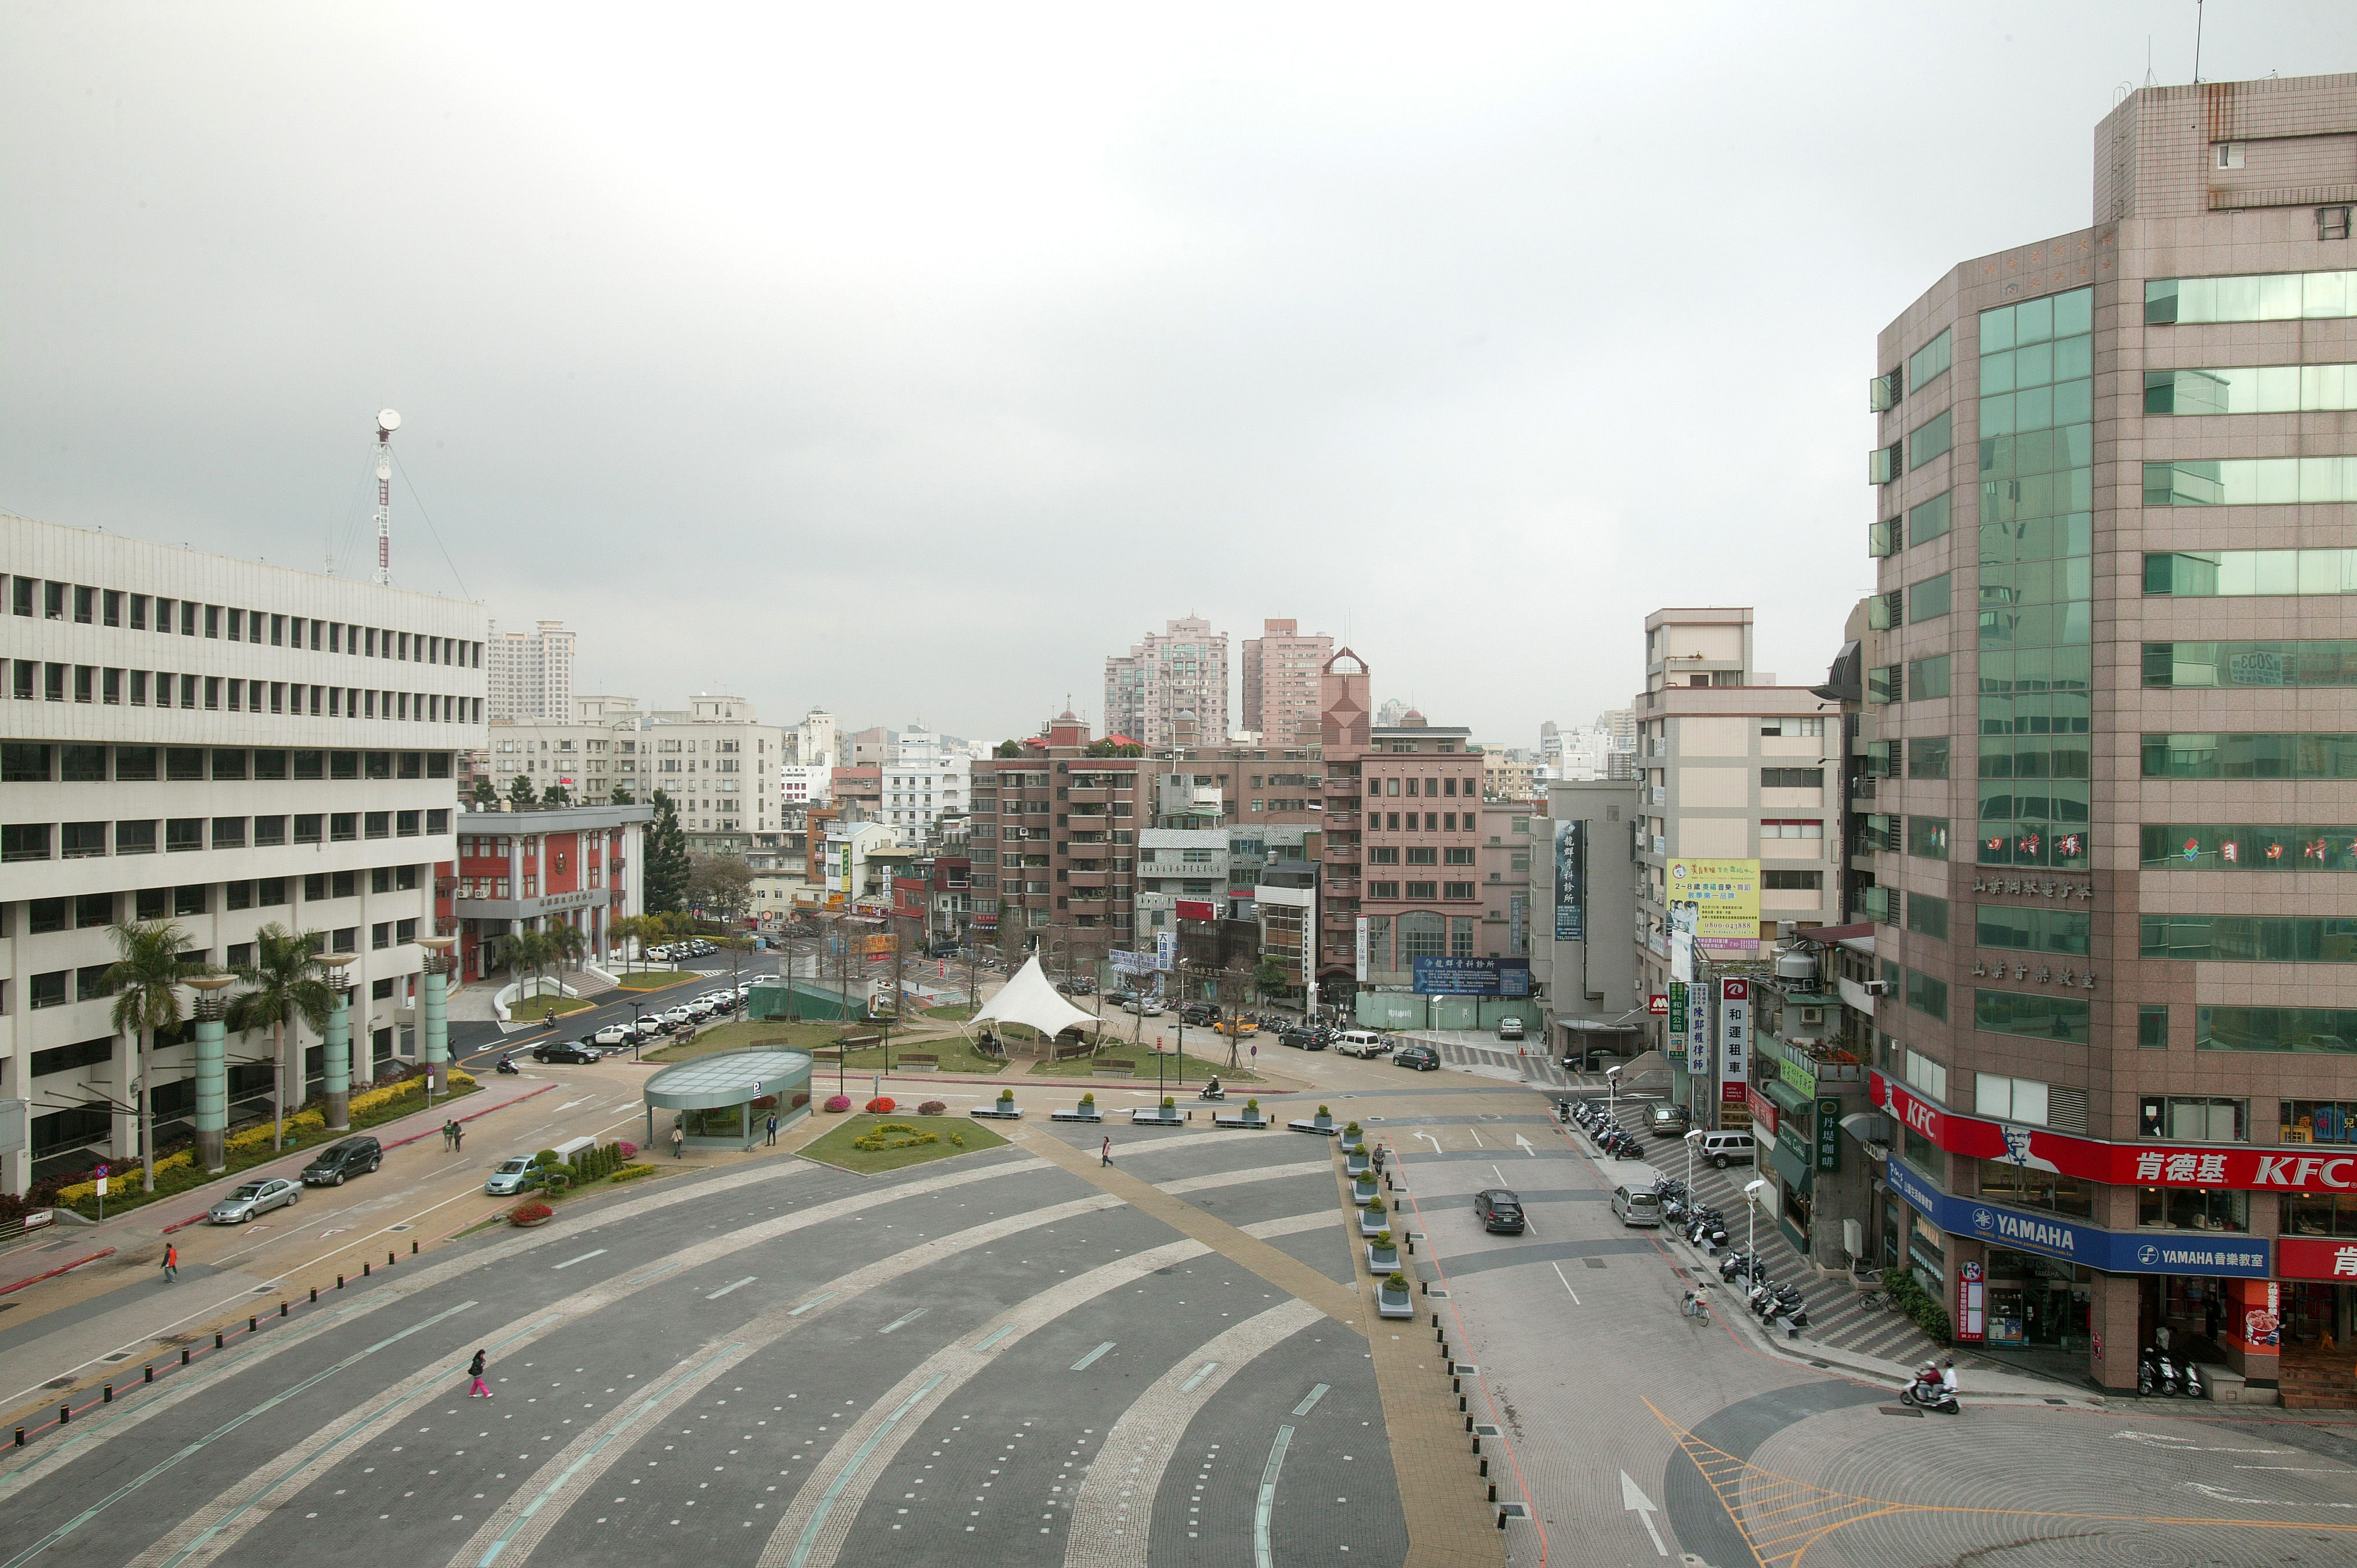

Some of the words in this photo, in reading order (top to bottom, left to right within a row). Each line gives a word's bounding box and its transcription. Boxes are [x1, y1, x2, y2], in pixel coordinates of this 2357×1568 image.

[1972, 959, 2095, 989] 山葉音樂教室
[1728, 1008, 1741, 1073] 和運租車
[754, 1083, 759, 1094] P
[1906, 1098, 1936, 1138] KFC
[1793, 1138, 1805, 1158] Coffee
[1822, 1117, 1834, 1167] 丹堤咖啡
[2136, 1152, 2227, 1184] 肯德基
[2252, 1156, 2354, 1188] KFC
[1997, 1214, 2074, 1250] YAMAHA
[2035, 1269, 2059, 1277] YAMAHA
[2162, 1250, 2213, 1265] YAMAHA
[2214, 1252, 2263, 1267] 音樂教室
